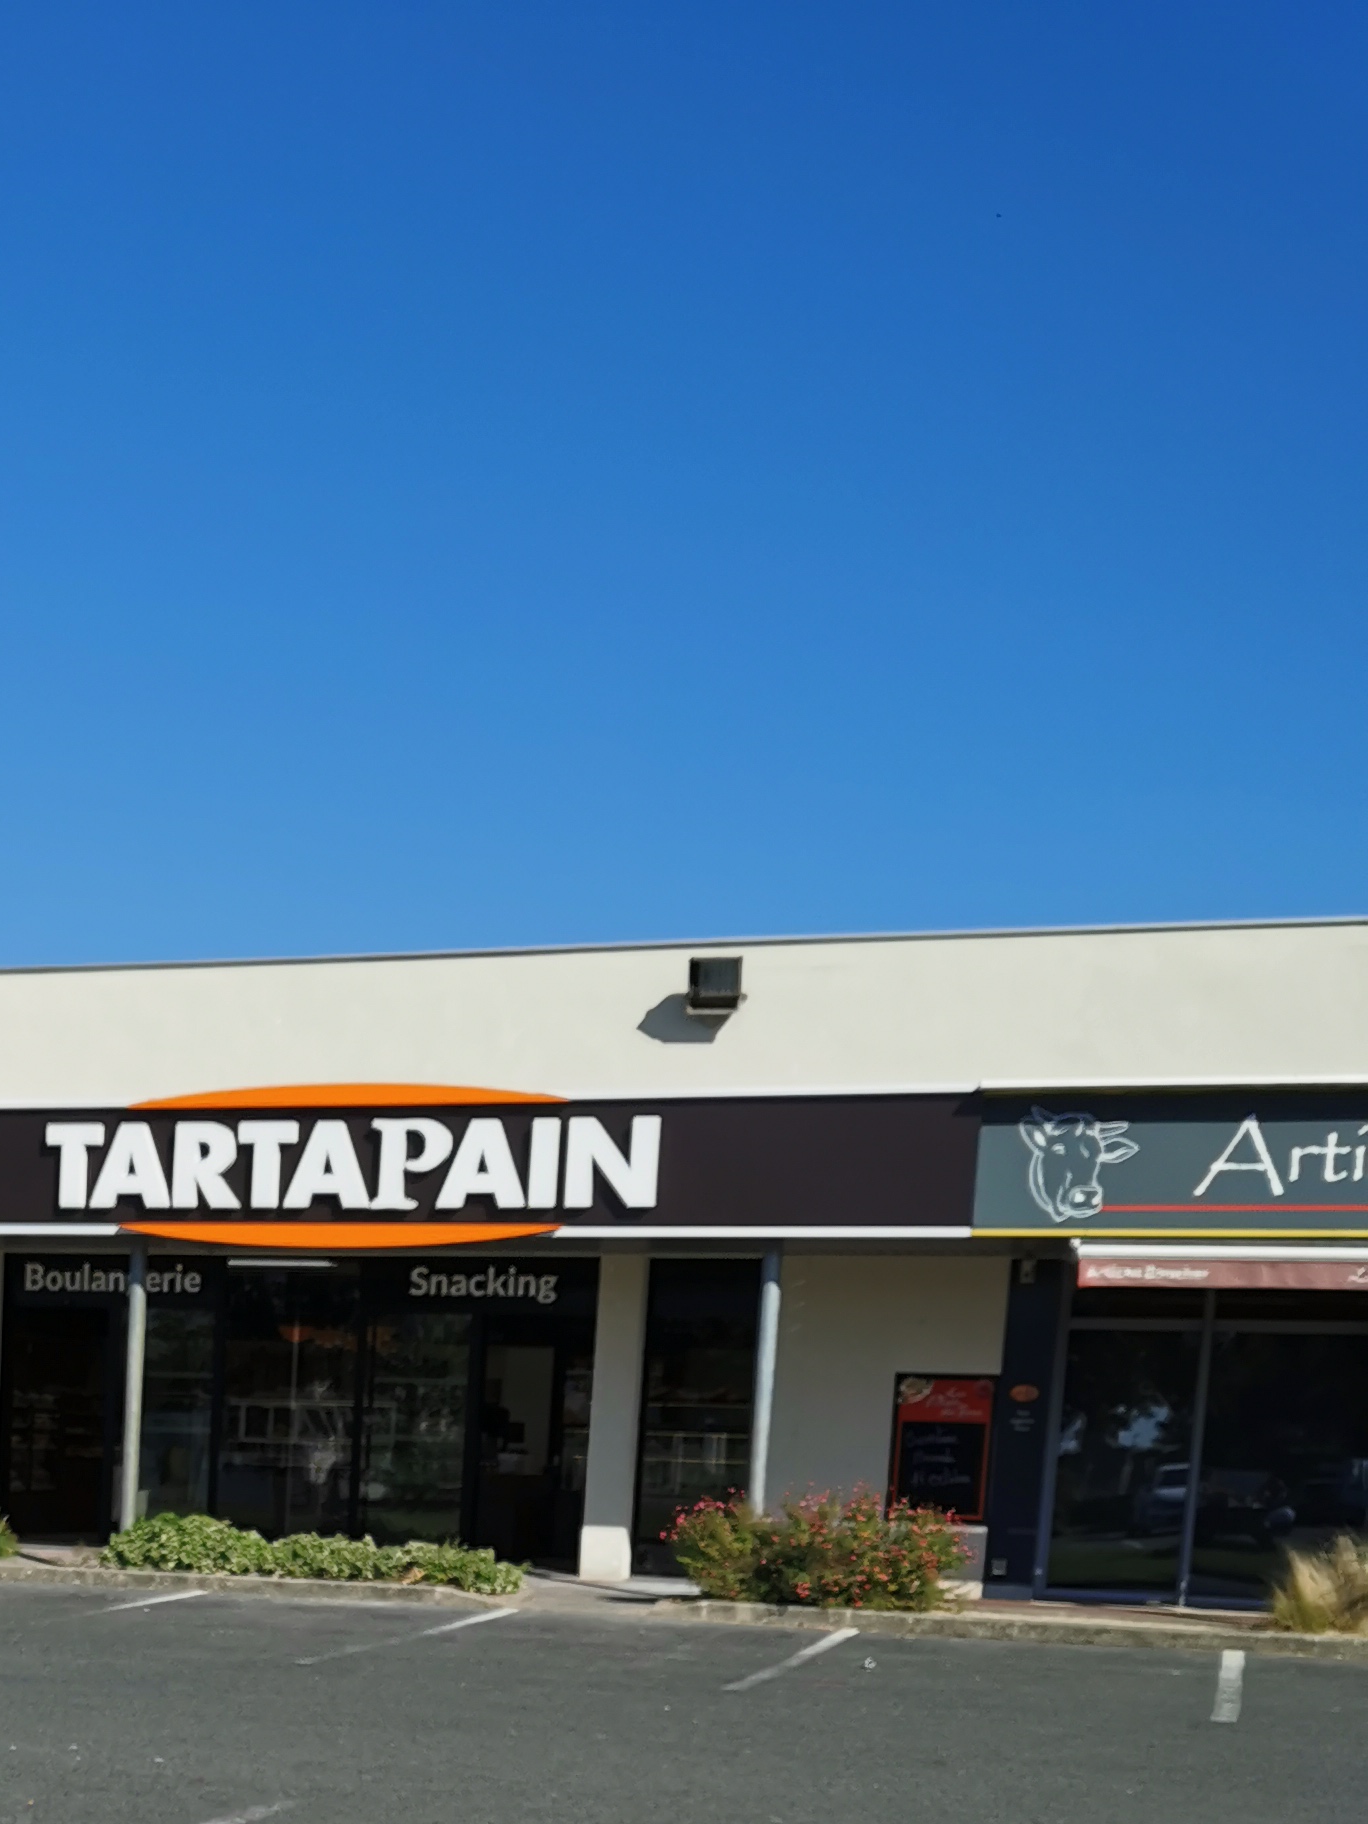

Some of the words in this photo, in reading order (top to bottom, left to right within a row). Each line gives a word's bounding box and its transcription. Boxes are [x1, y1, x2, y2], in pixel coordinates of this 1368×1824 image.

[45, 1115, 662, 1211] TARTAPAIN
[24, 1261, 202, 1296] Boulanerie
[408, 1265, 559, 1304] Snacking
